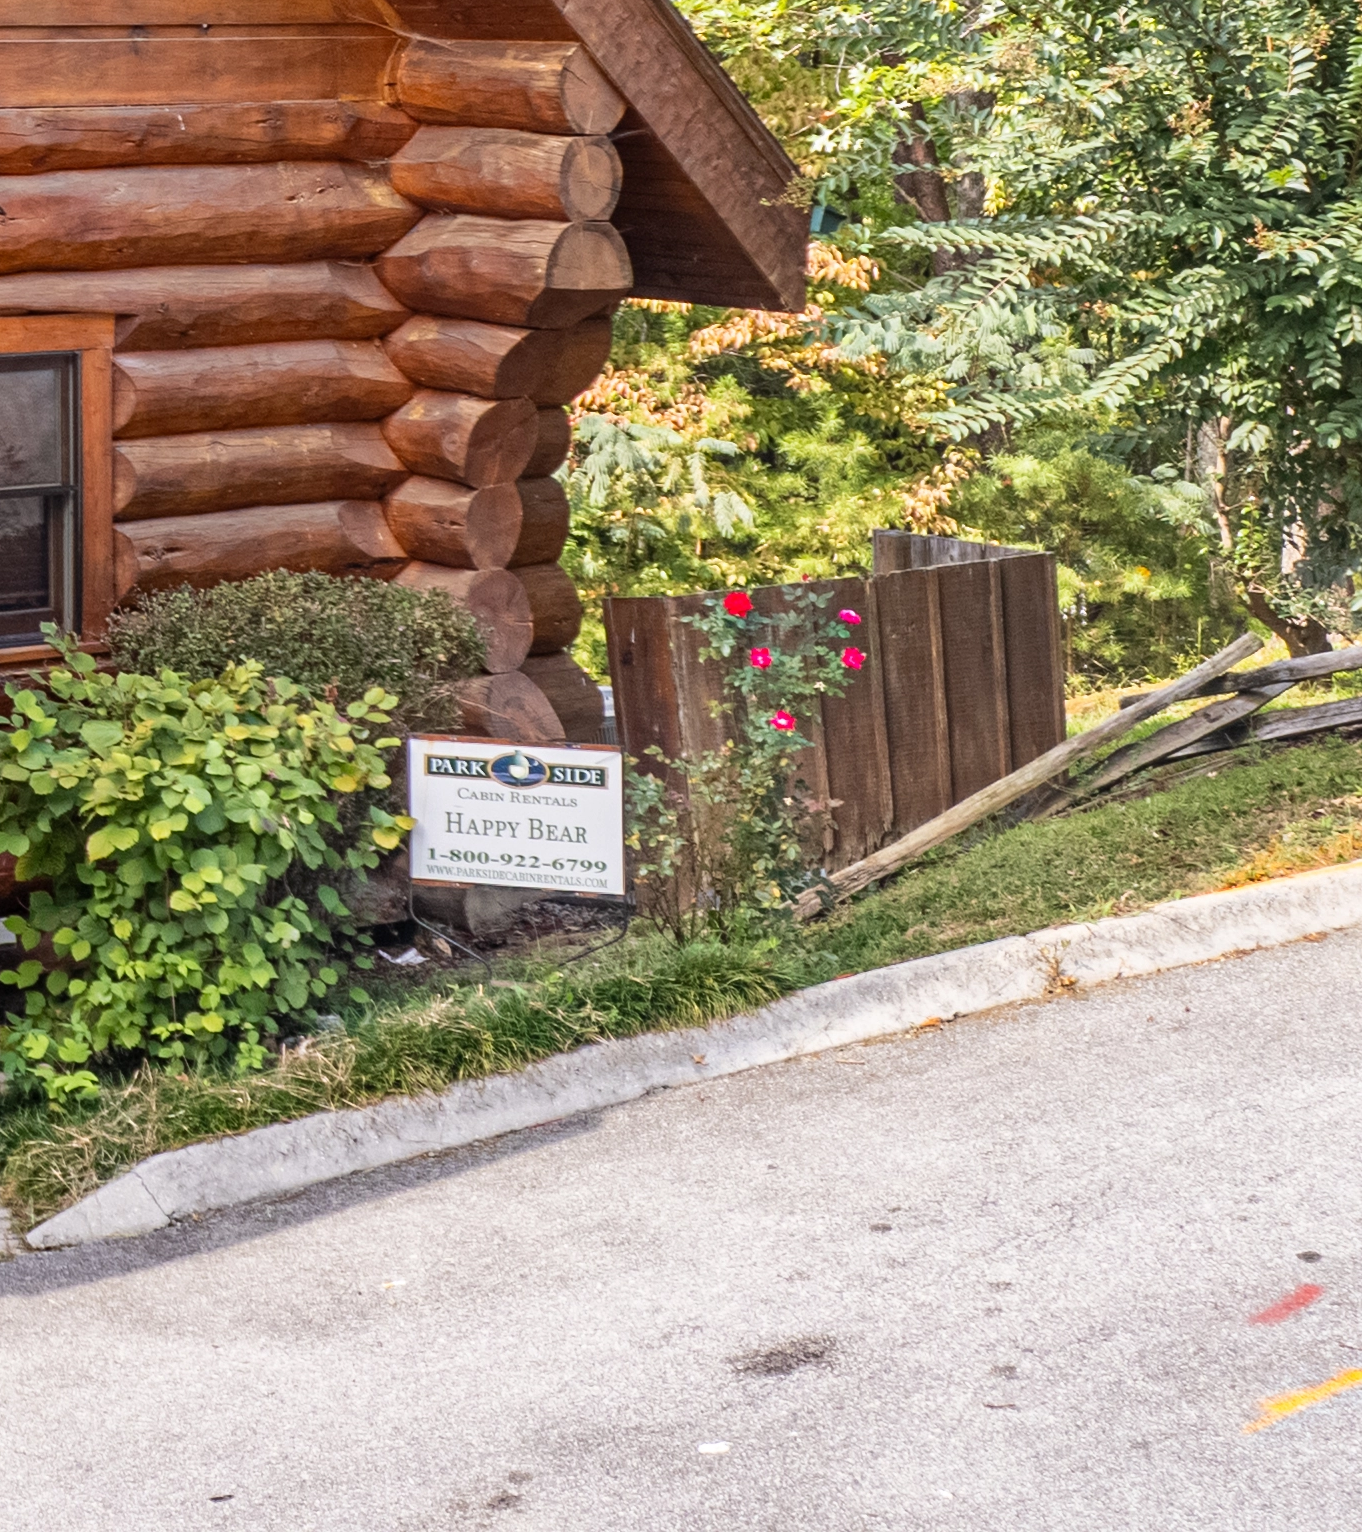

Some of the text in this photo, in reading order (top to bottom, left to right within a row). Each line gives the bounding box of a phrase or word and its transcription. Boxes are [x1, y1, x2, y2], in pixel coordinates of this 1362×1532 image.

[430, 758, 602, 785] PARK SIDE
[427, 848, 607, 873] 1-800-922-6799
[426, 865, 608, 888] WWW.PARKSIDECABINRENTALS.COM
